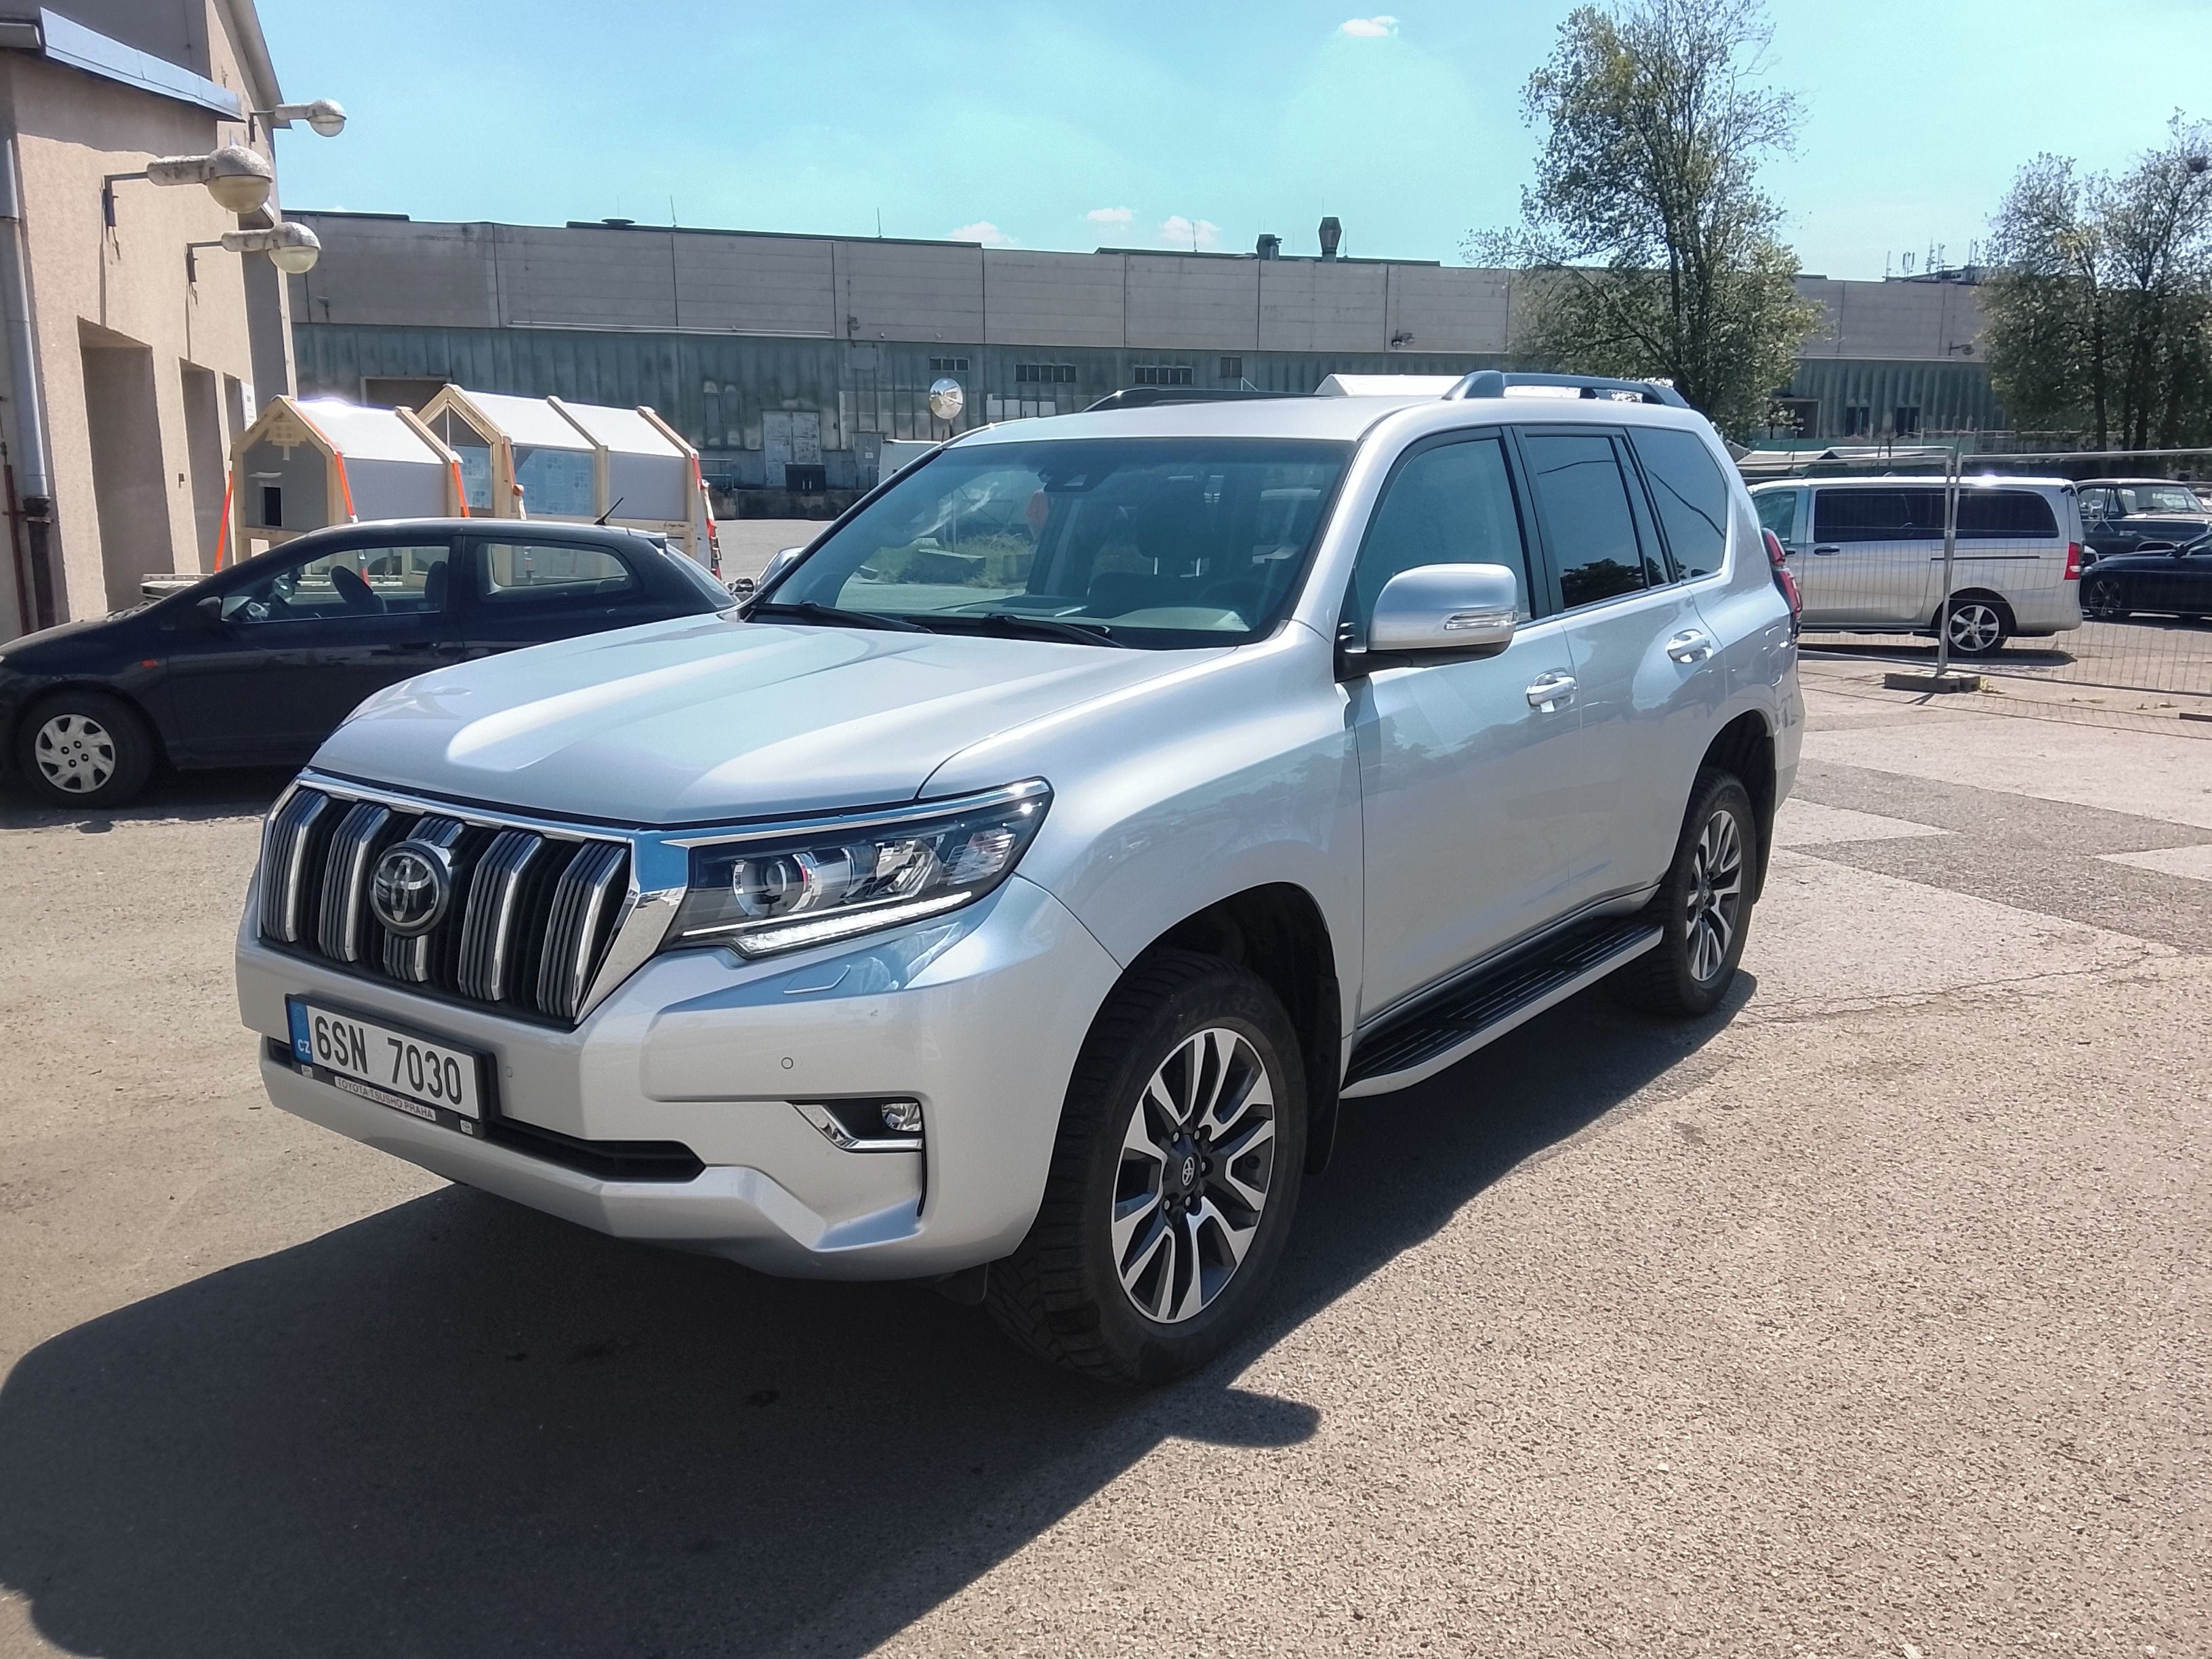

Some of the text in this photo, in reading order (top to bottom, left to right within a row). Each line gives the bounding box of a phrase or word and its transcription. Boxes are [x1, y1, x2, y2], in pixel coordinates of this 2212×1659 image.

[298, 1038, 311, 1054] CZ
[314, 1015, 462, 1105] 6SN 7030
[337, 1078, 434, 1119] TOYOTA TSUSHO PRAHA
